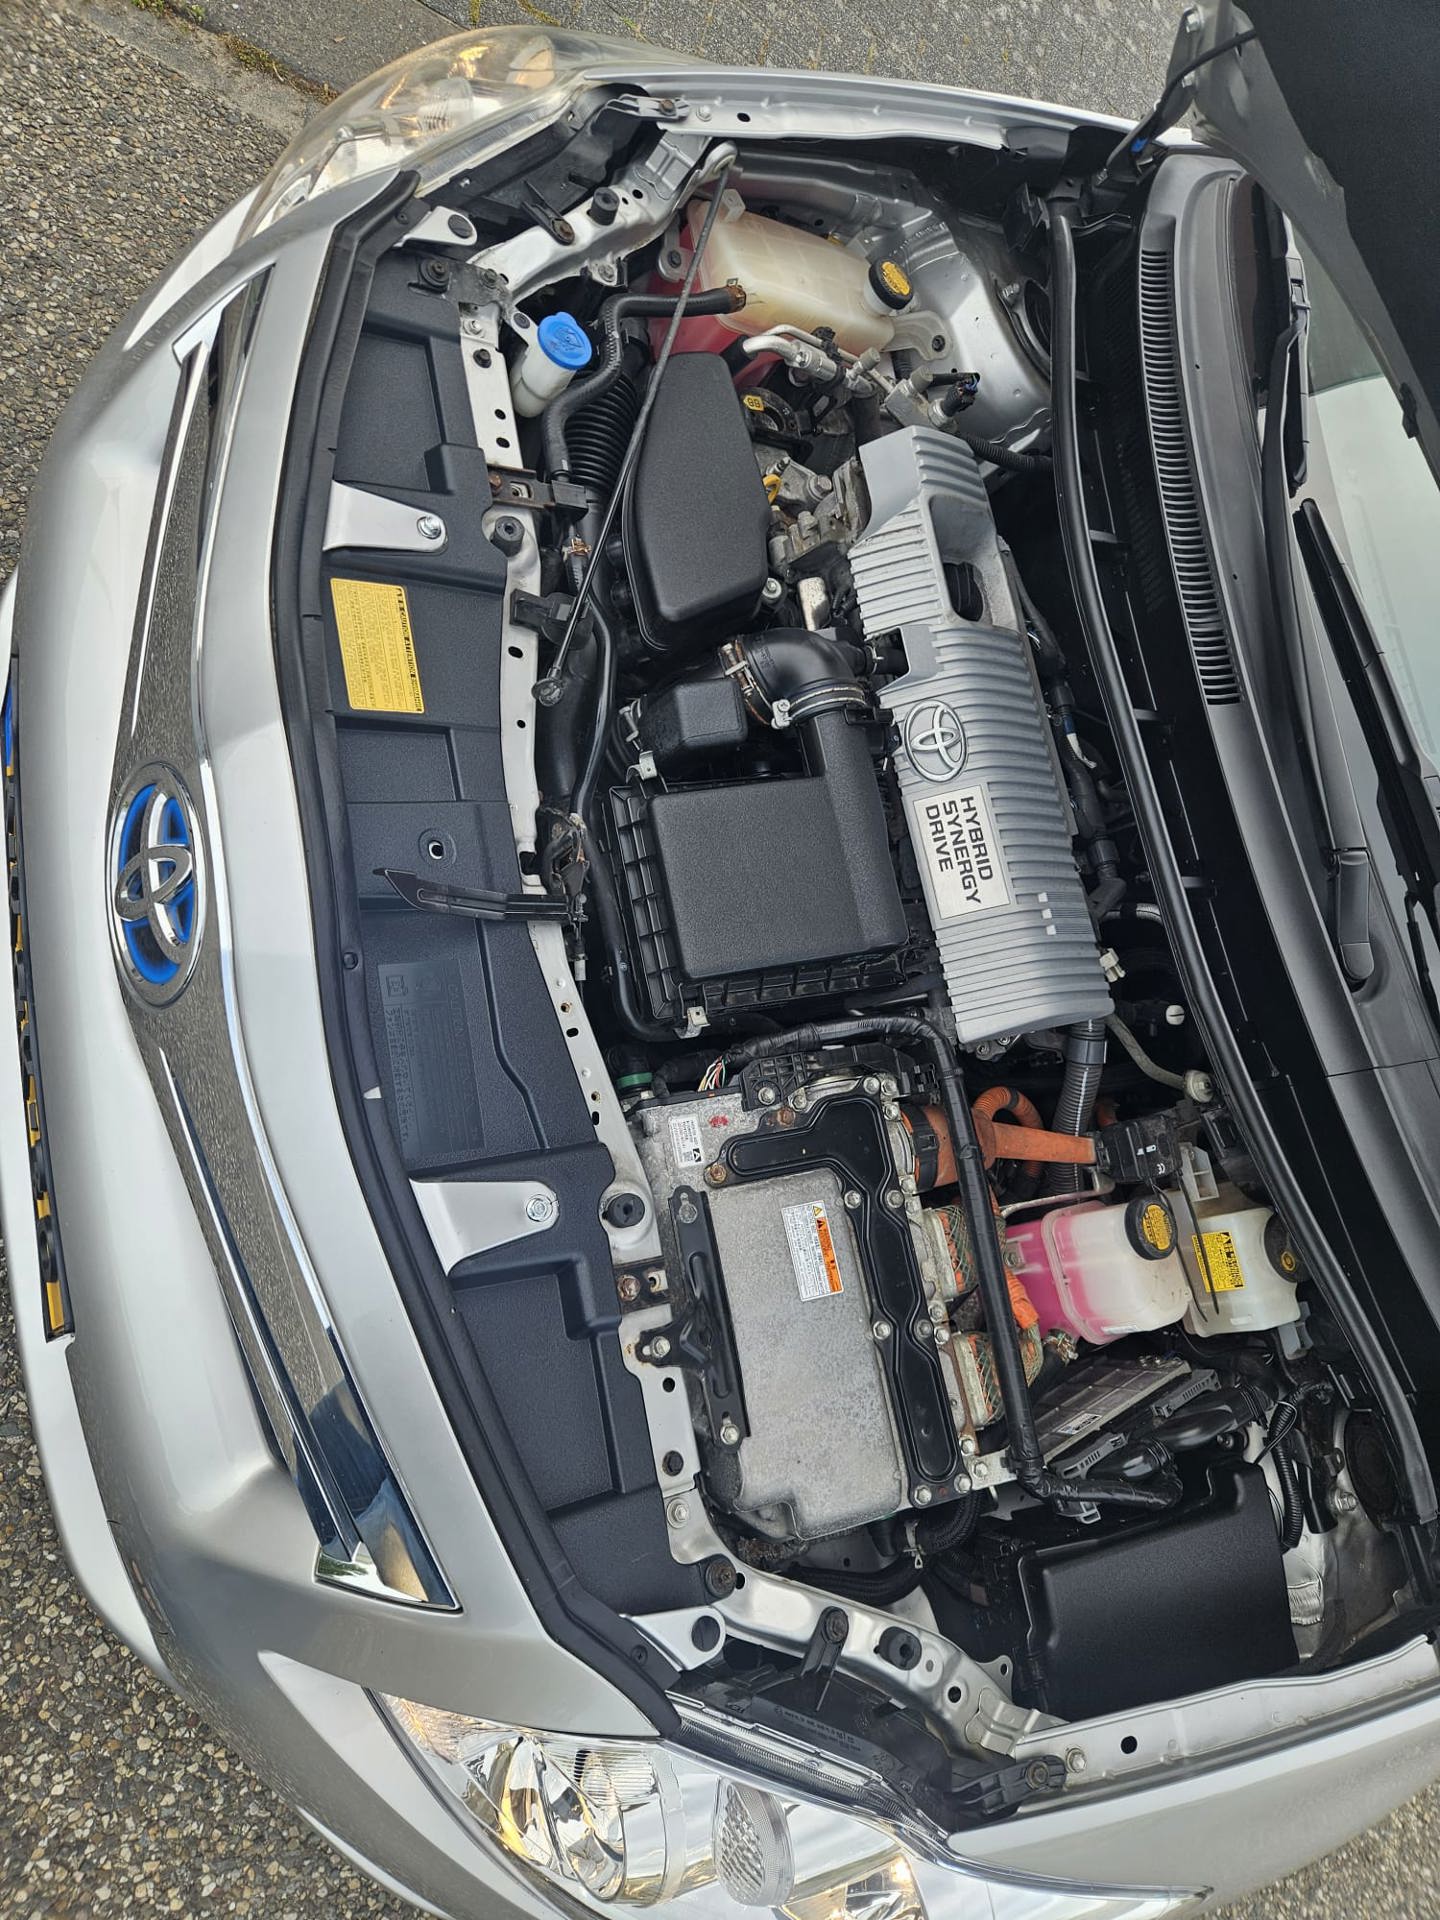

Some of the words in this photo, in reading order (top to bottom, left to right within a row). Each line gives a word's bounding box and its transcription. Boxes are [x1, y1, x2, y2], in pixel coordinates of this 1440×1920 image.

[925, 804, 953, 872] DRIVE
[943, 801, 981, 904] SYNERGY
[961, 796, 993, 881] HYBRID
